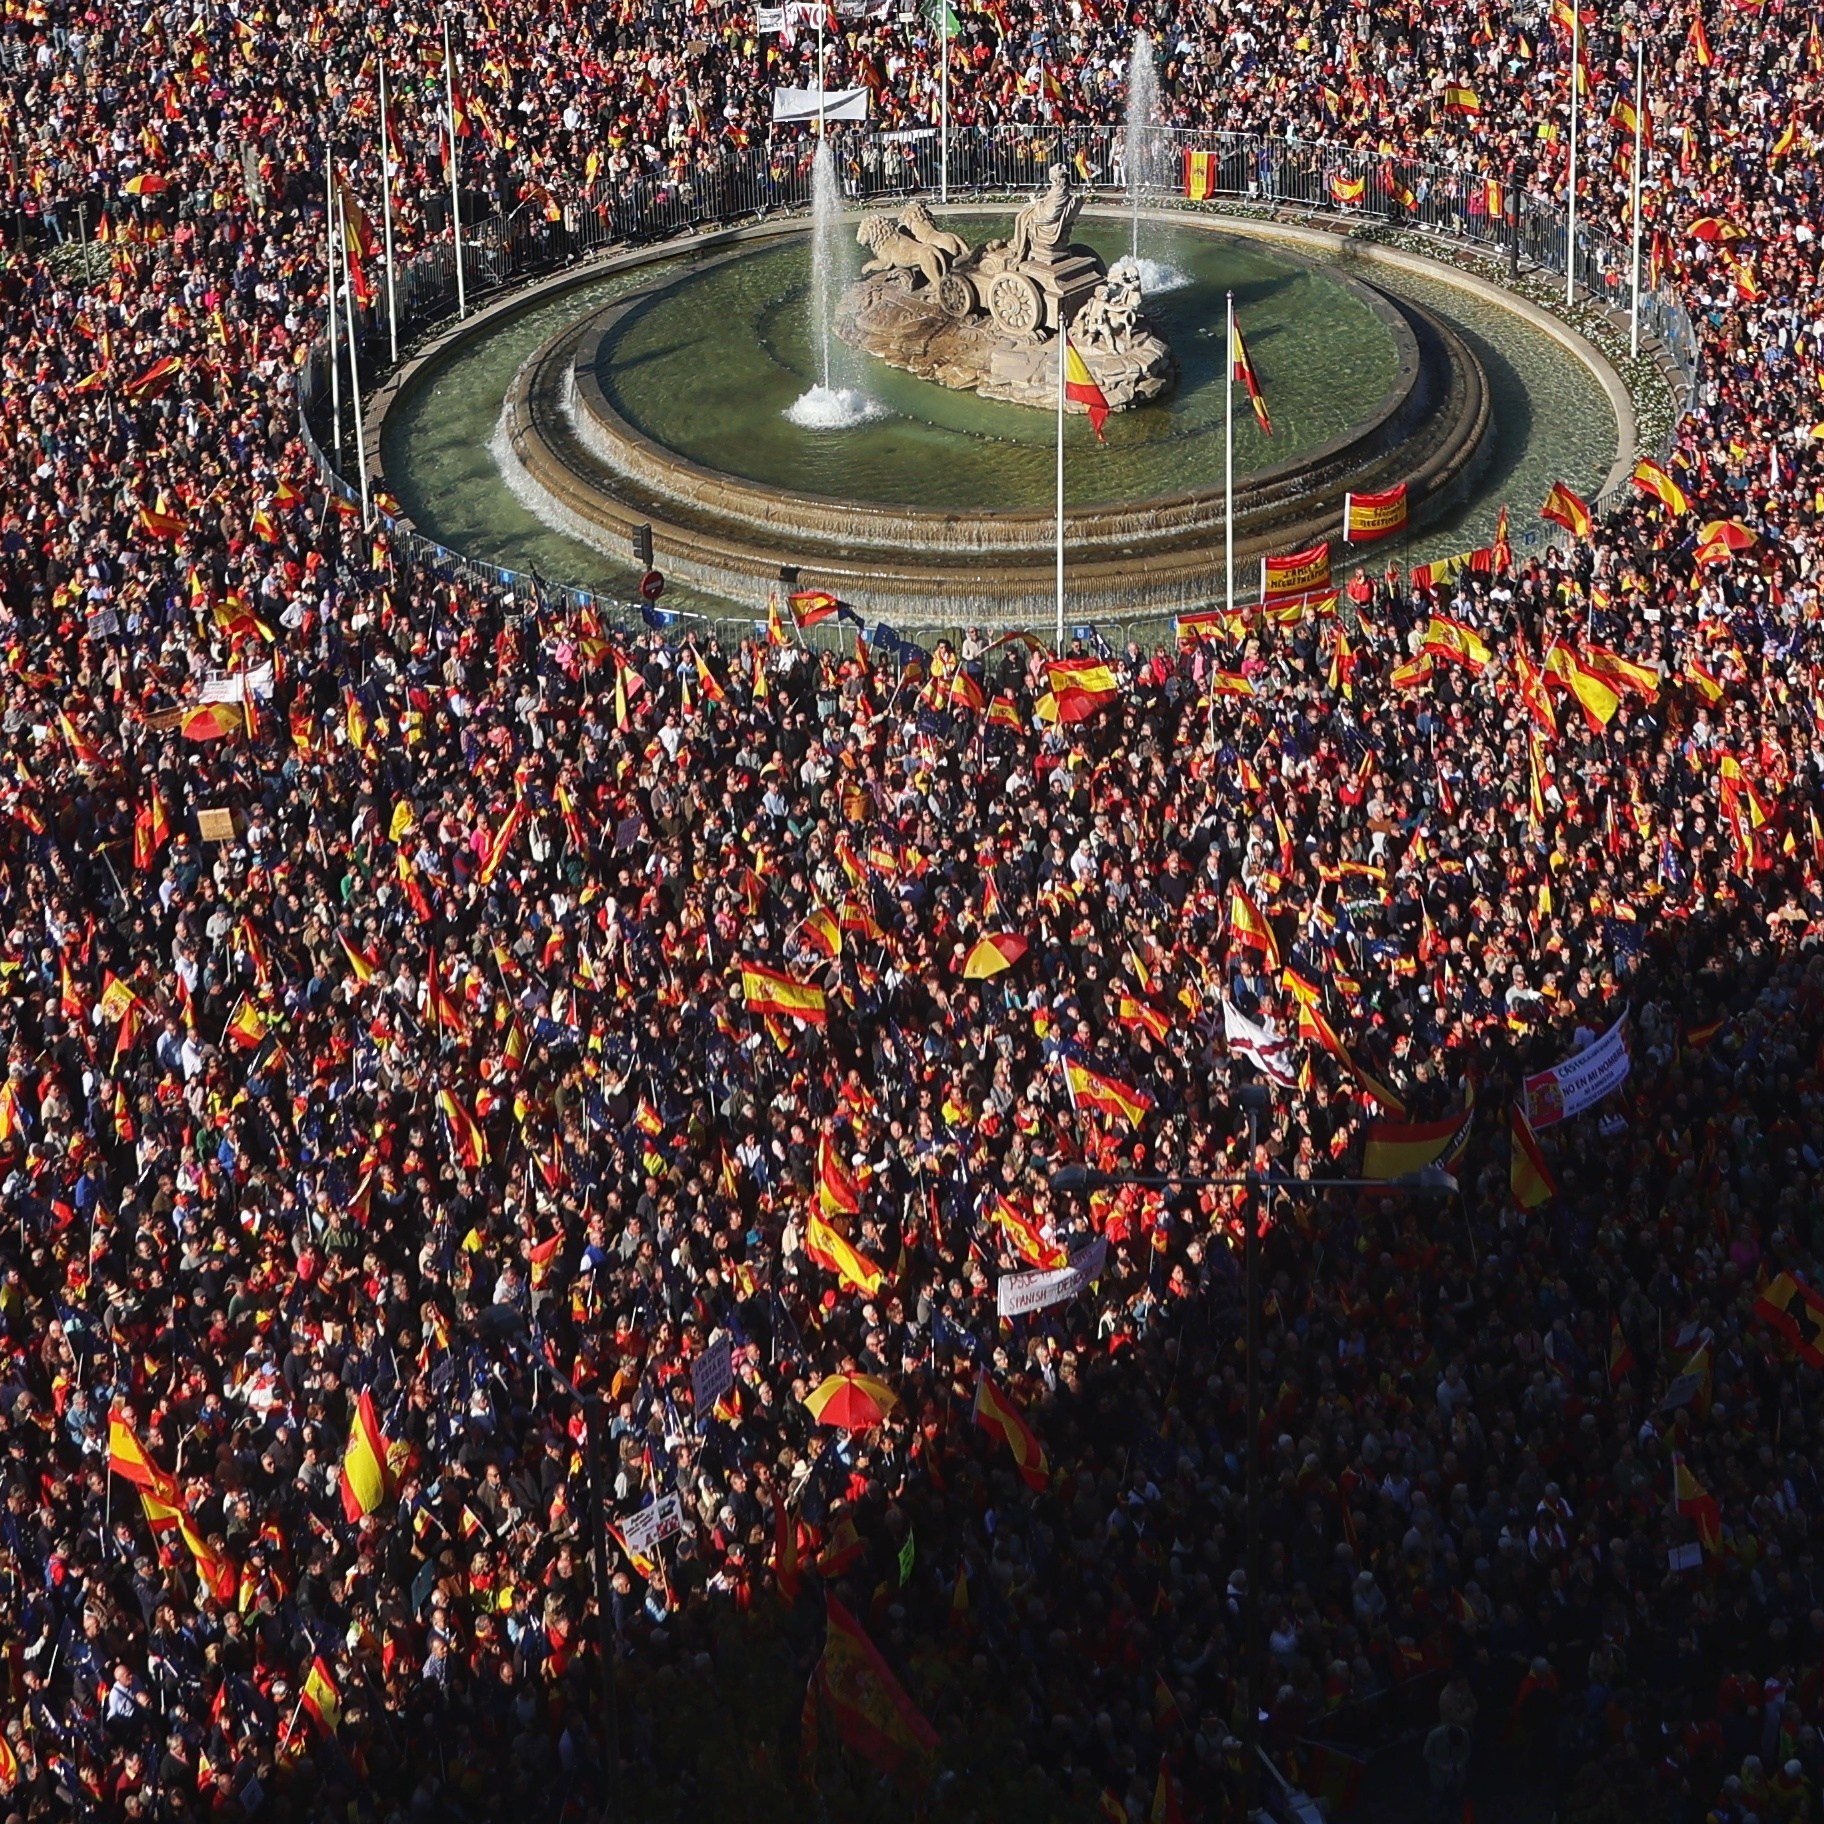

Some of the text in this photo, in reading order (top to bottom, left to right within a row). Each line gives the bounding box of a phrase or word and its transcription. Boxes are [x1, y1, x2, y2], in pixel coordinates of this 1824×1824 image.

[1562, 1083, 1575, 1097] NO
[1576, 1076, 1587, 1088] EN
[1598, 1044, 1624, 1077] NOMBRE
[1009, 1289, 1047, 1311] SPANISH
